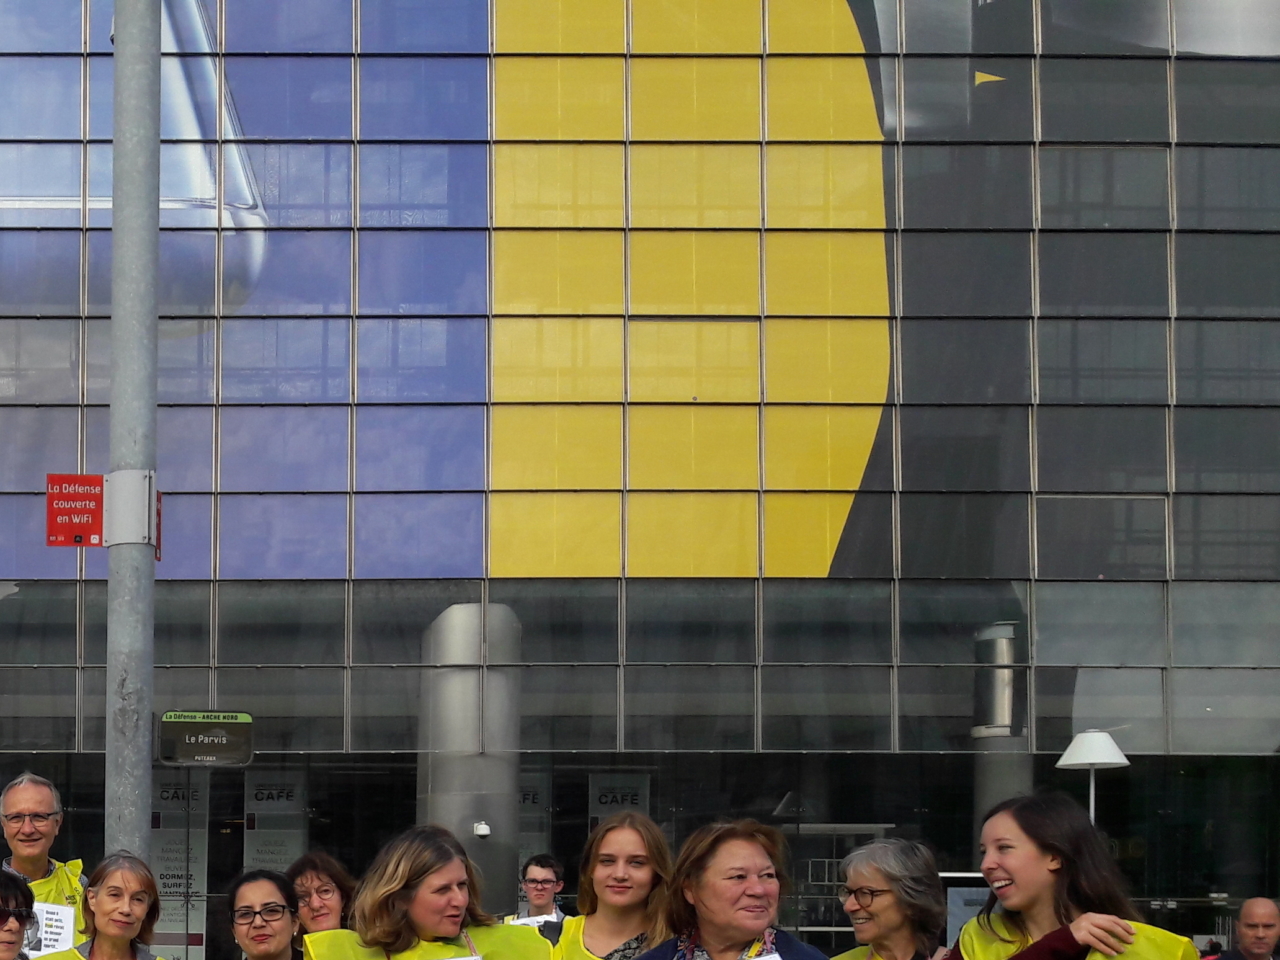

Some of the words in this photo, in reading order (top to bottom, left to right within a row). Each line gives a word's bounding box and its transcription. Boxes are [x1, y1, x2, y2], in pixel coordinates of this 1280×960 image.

[48, 483, 60, 493] La
[62, 483, 101, 494] Défense
[53, 499, 96, 509] couverte
[56, 515, 69, 524] en
[71, 514, 92, 524] WiFi
[185, 734, 196, 744] Le
[198, 734, 227, 744] Parvis
